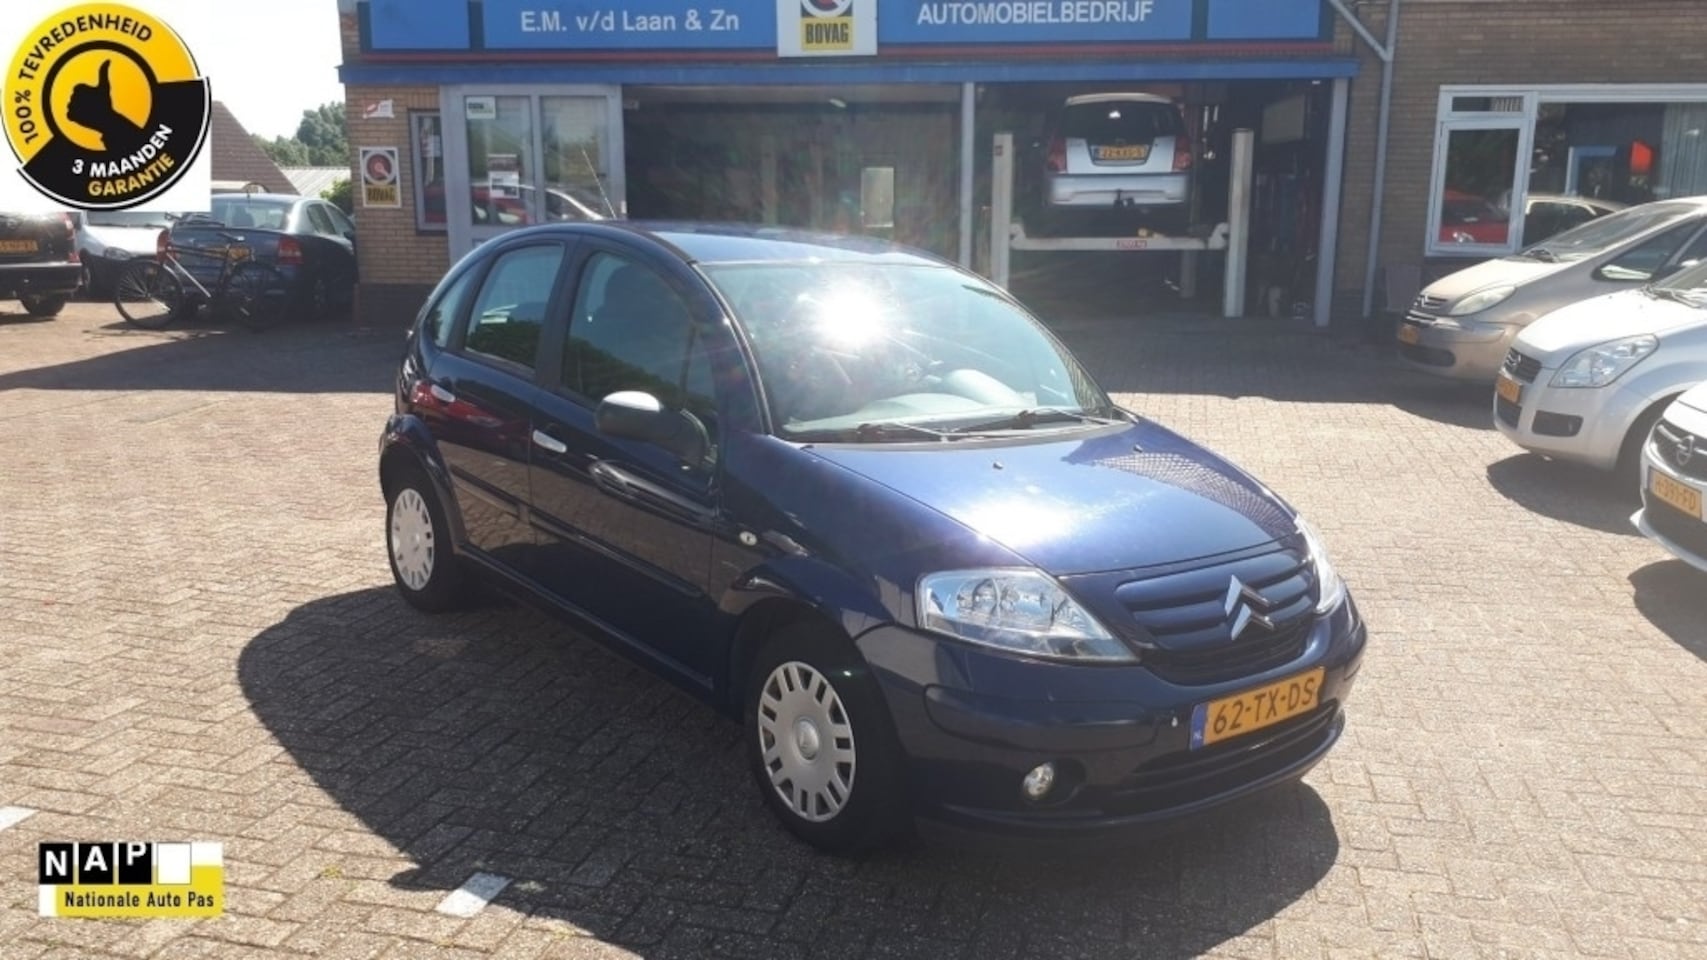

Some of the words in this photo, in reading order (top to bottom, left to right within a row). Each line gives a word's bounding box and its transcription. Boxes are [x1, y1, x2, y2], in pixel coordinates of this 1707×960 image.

[520, 10, 567, 32] E.M.
[576, 10, 615, 32] v/d
[622, 10, 677, 31] Laan
[684, 9, 702, 31] &
[709, 9, 740, 31] Zn
[916, 1, 1153, 25] AUTOMOBIELBEDRIJF
[805, 23, 849, 44] BOVAG
[1213, 677, 1315, 734] 62-TX-DS
